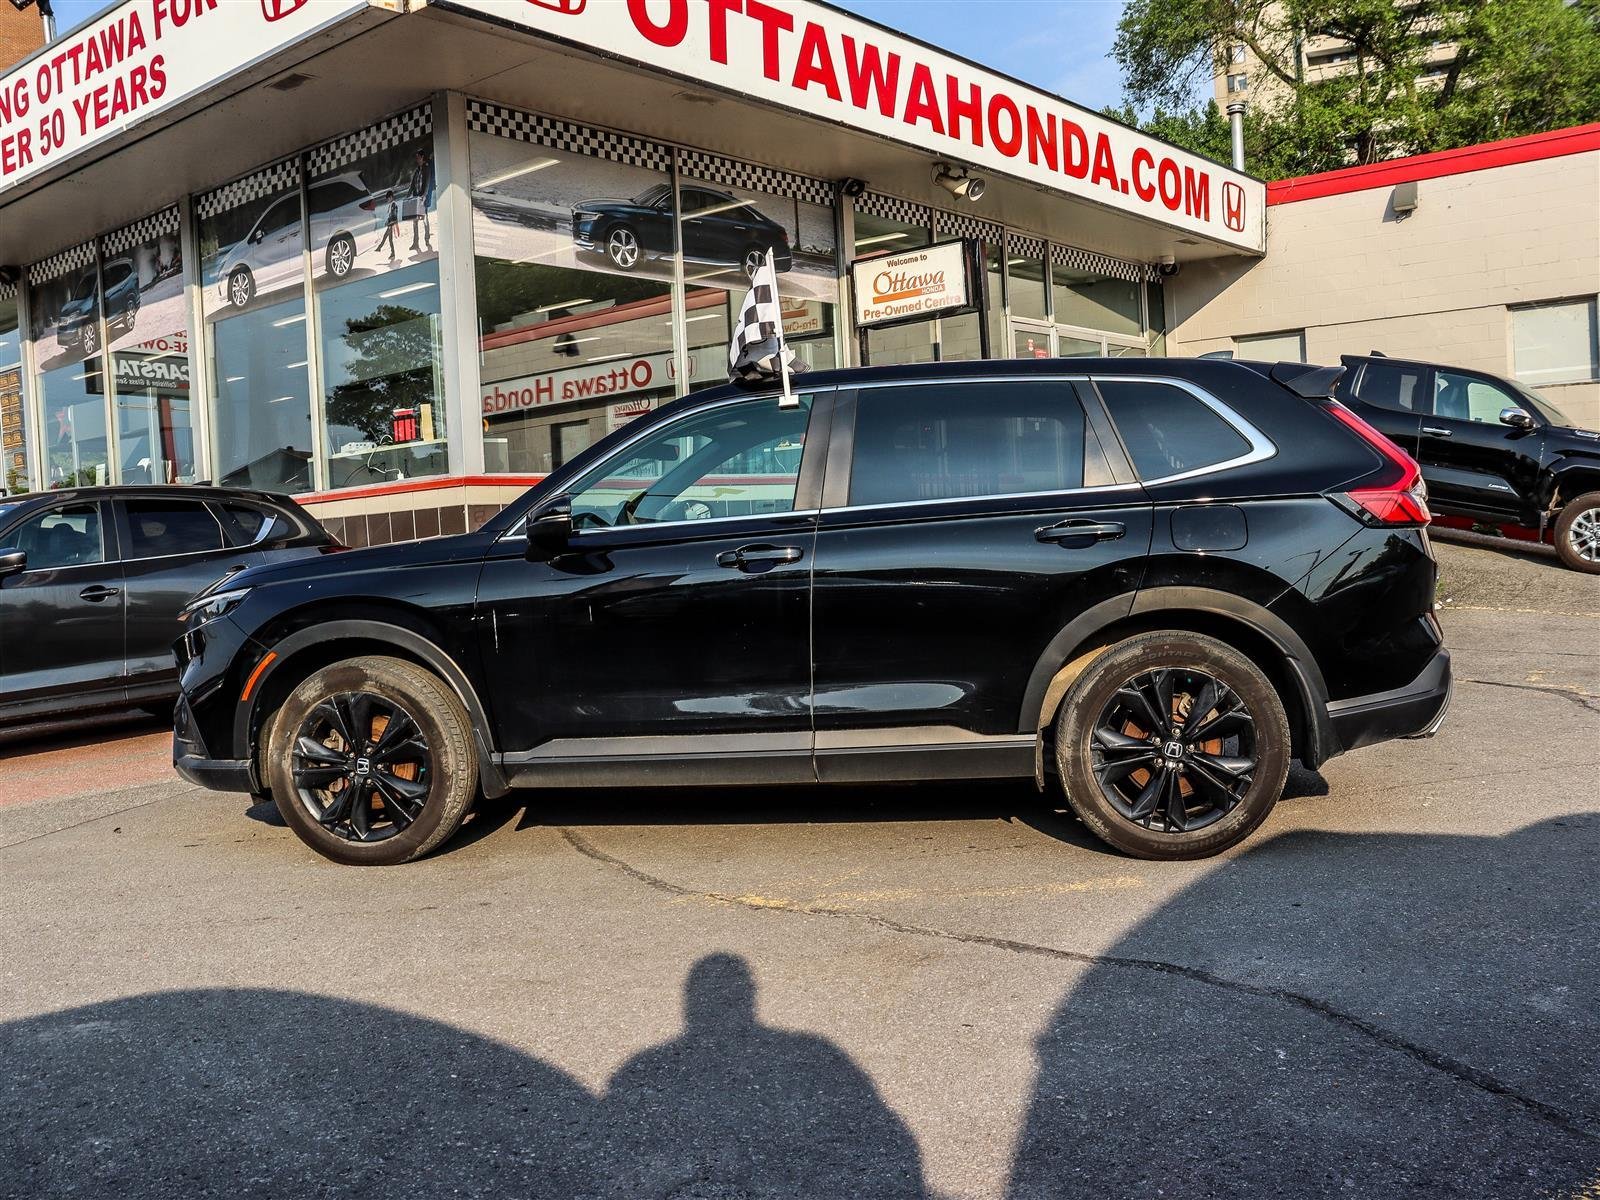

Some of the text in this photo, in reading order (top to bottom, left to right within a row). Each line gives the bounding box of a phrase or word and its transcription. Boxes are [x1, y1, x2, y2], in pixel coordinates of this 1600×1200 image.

[36, 10, 147, 105] OTTAWA
[1, 54, 167, 176] ER 50 YEARS
[627, 0, 1210, 222] OTTAWAHONDA.COM
[887, 253, 928, 267] Welcome to
[873, 270, 945, 295] Ottawa
[922, 285, 945, 295] HONDA
[863, 300, 922, 320] Pre-Owned
